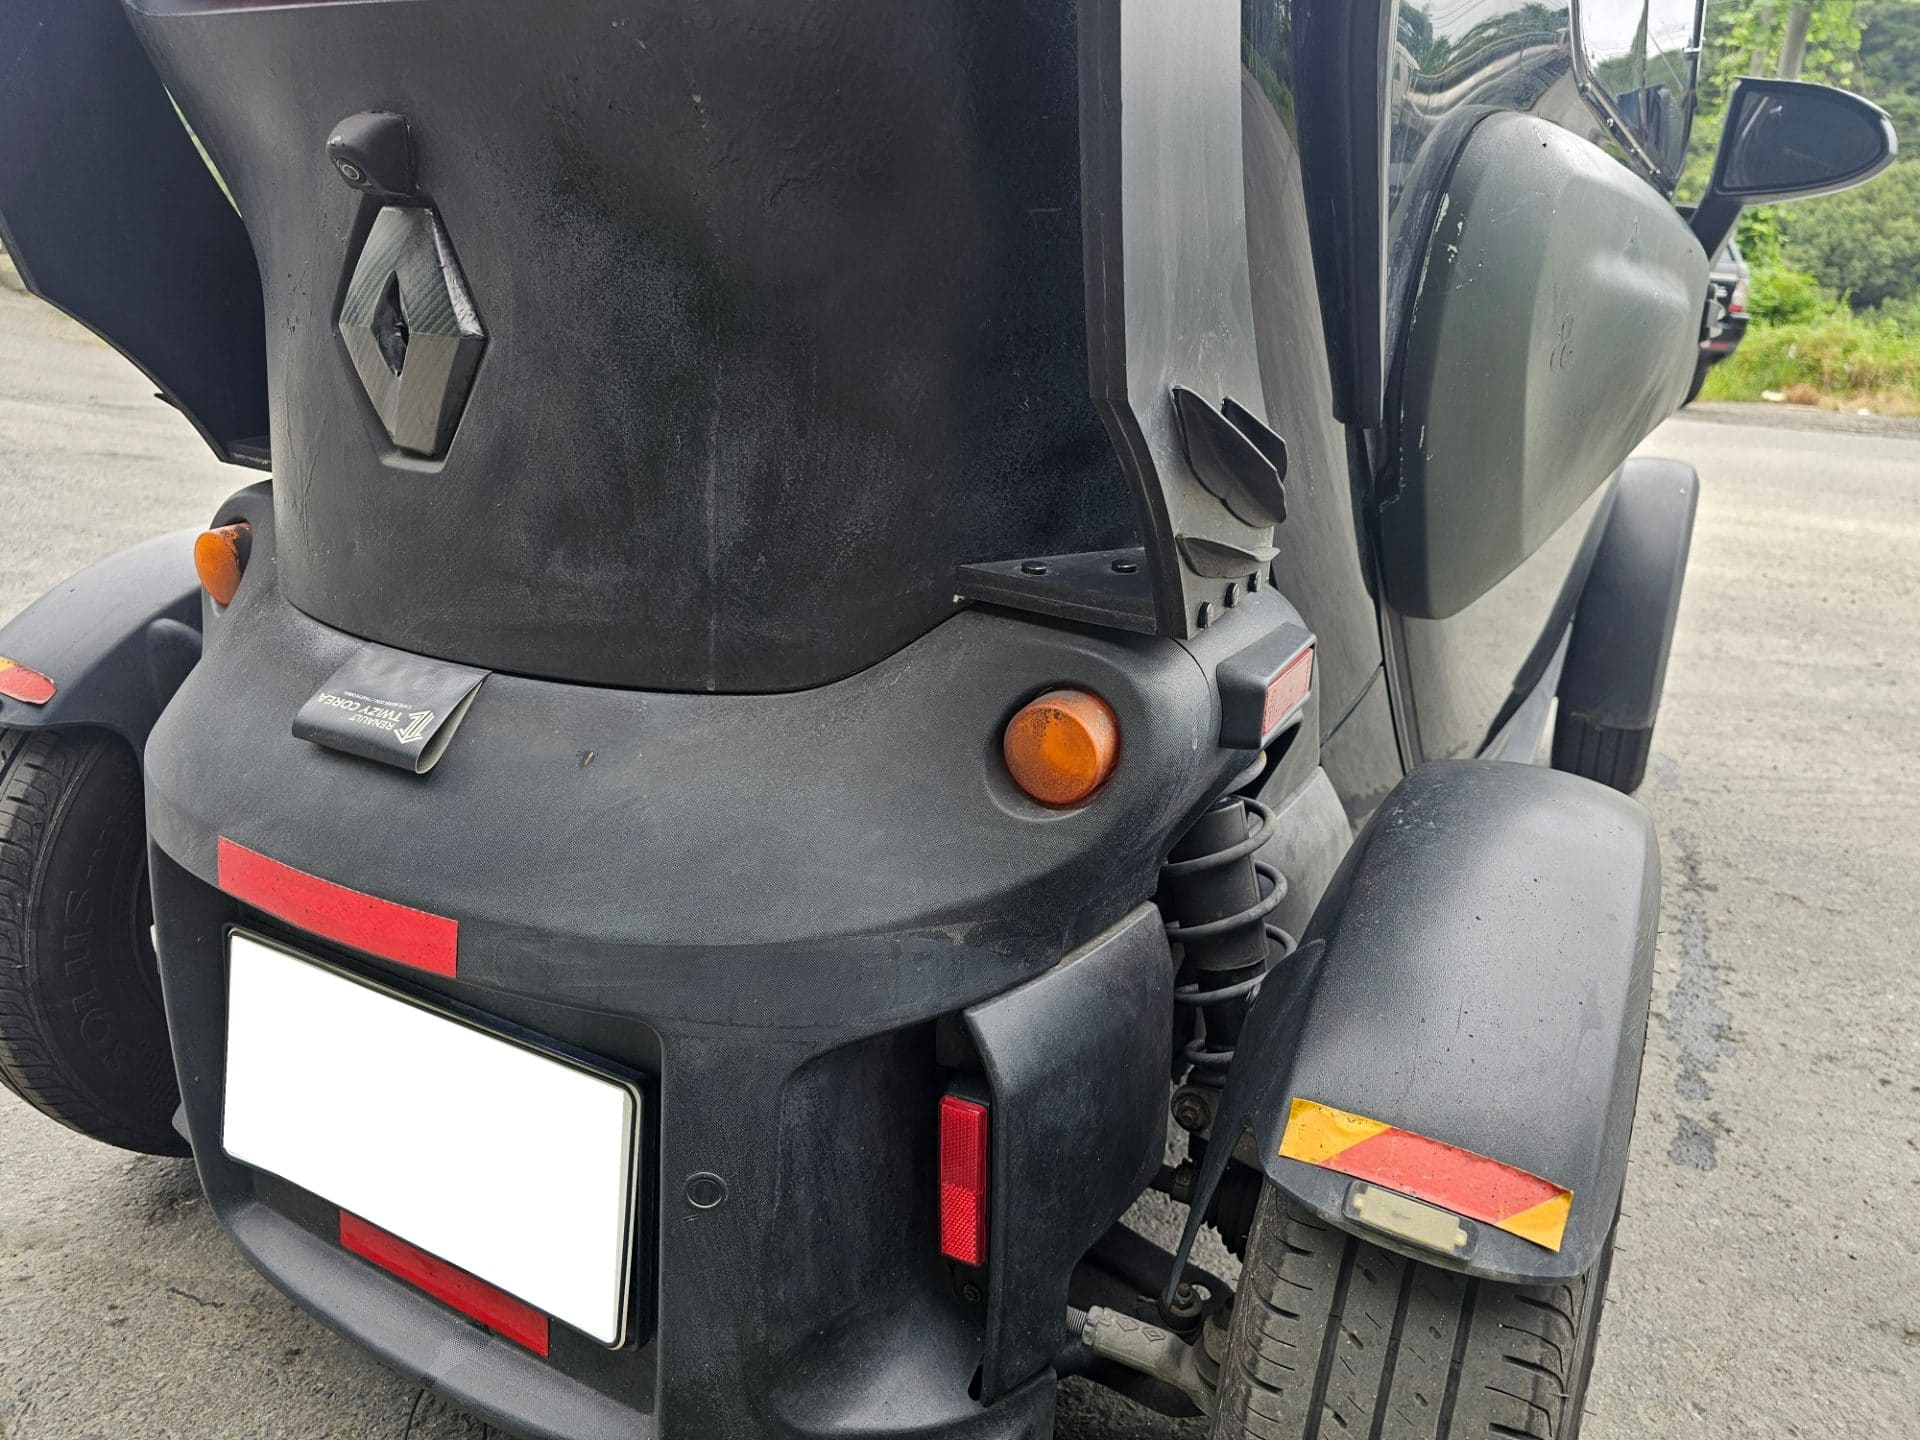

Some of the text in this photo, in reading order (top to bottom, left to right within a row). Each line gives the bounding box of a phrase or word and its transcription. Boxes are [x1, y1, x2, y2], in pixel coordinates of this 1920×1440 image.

[318, 693, 361, 711] COREA
[349, 713, 396, 731] RENAULT
[360, 705, 402, 722] TWIZY
